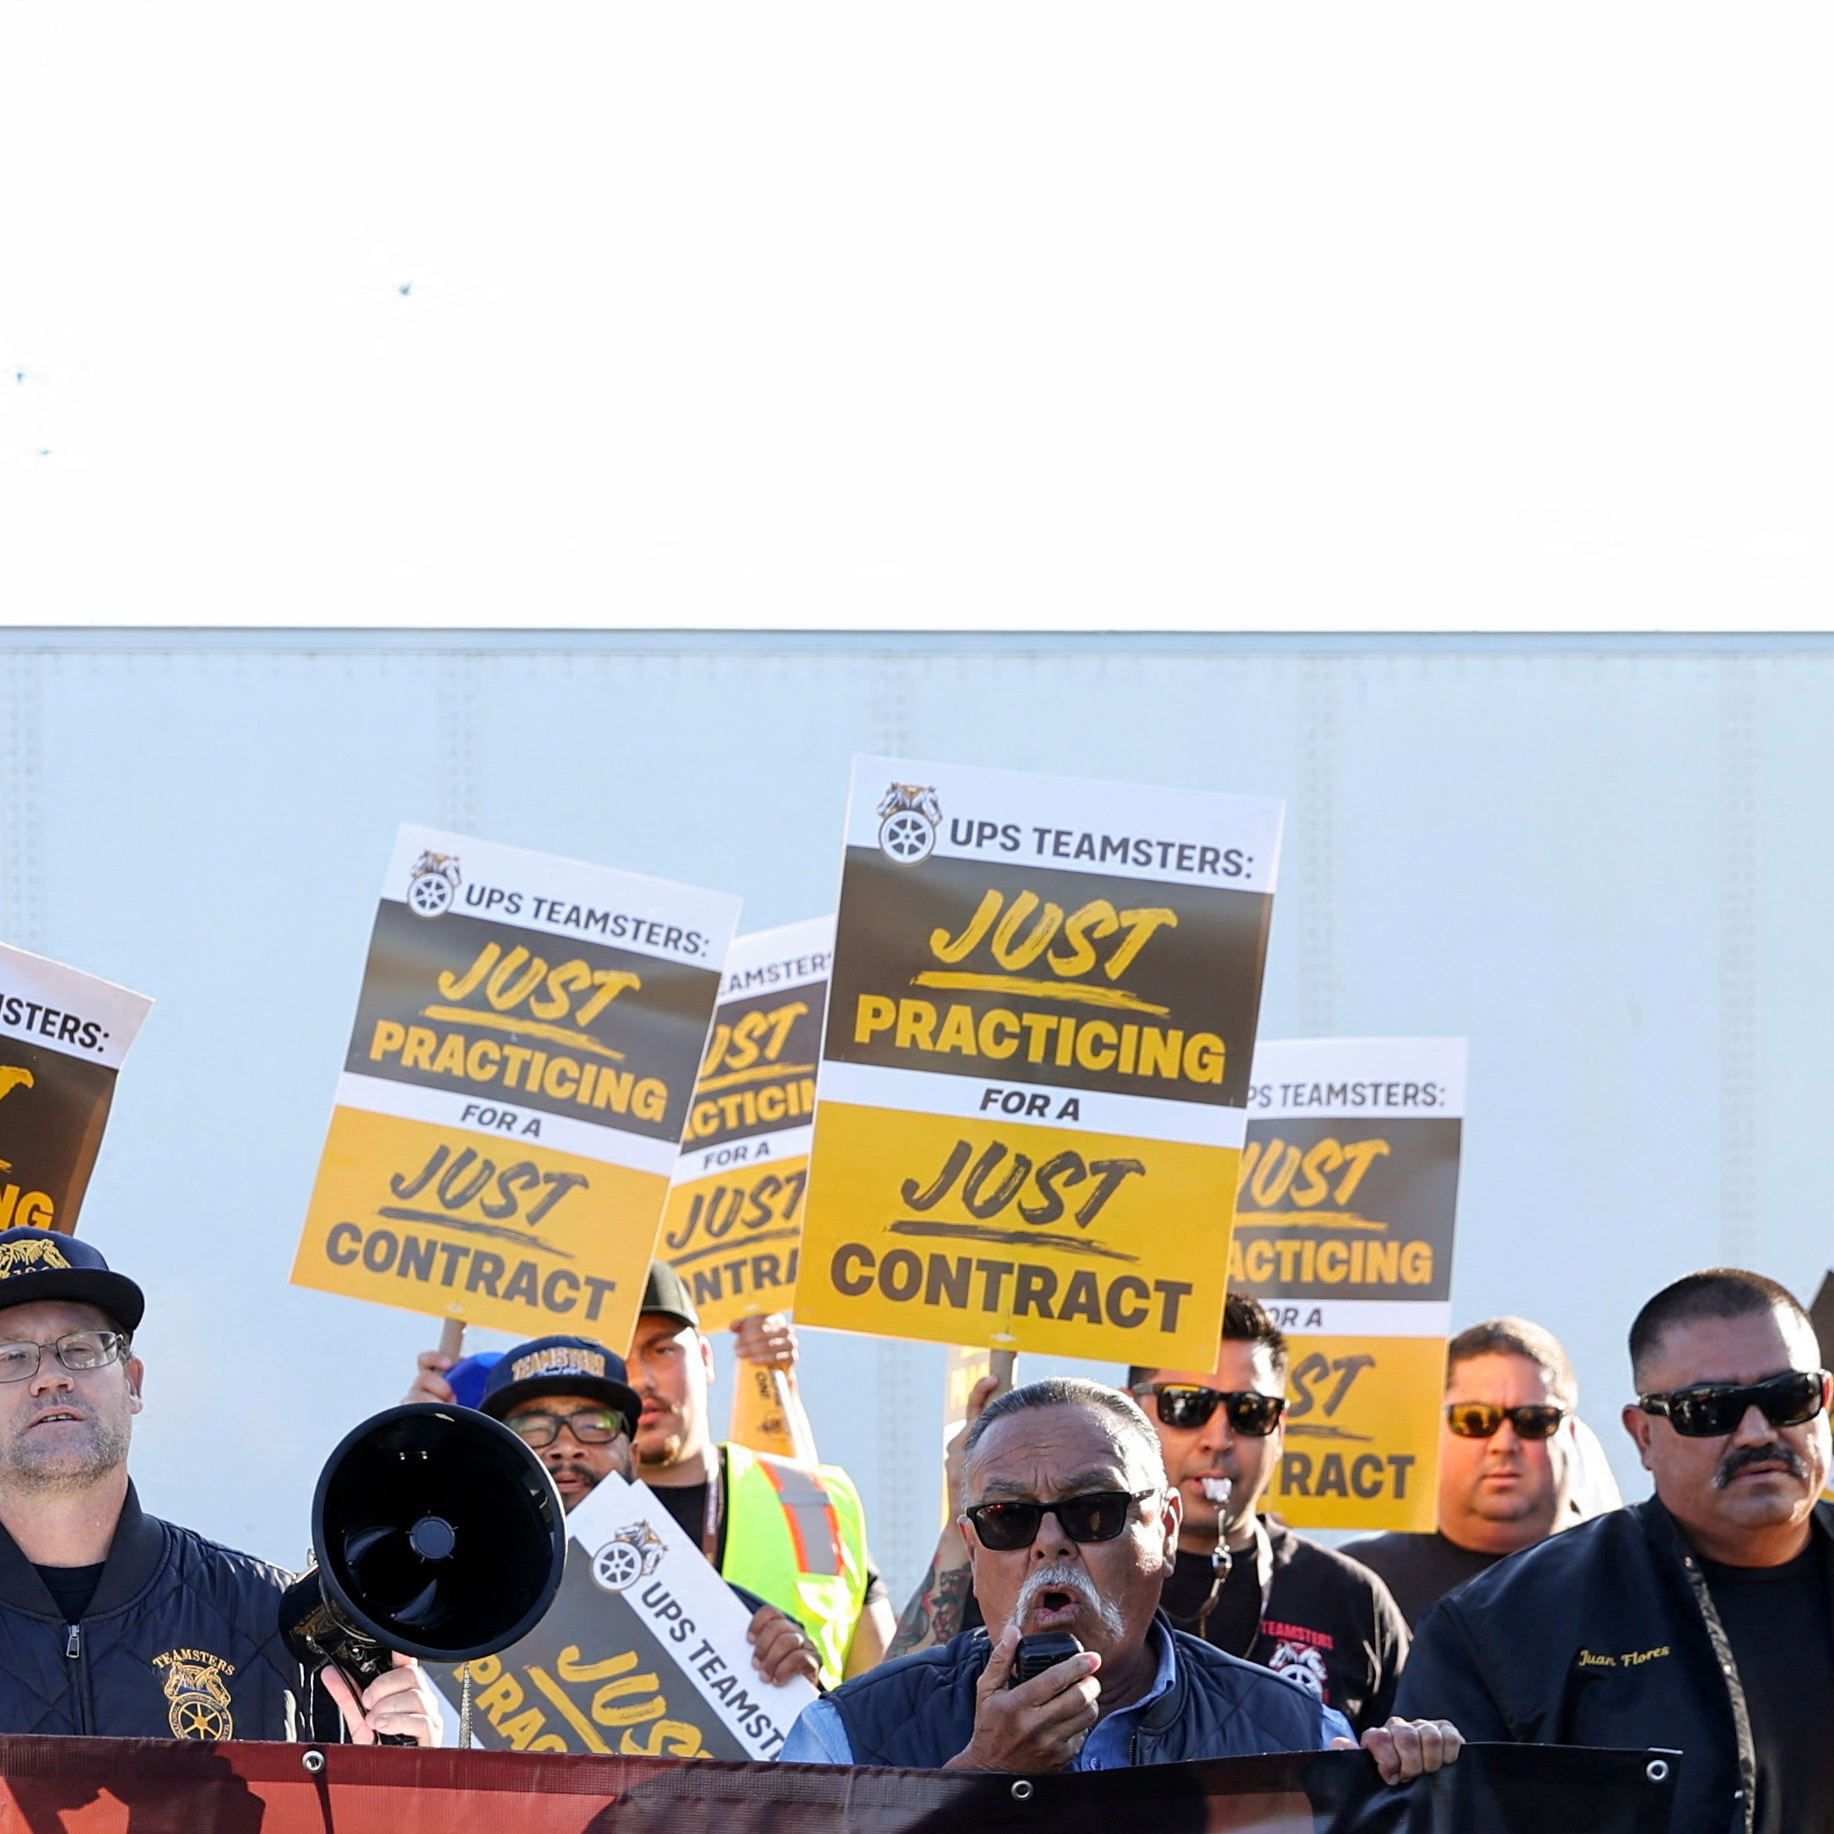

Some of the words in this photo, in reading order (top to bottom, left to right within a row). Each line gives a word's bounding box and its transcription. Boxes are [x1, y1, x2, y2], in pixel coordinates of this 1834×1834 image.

[950, 819, 1020, 854] UPS
[1033, 827, 1254, 878] TEAMSTERS:
[465, 884, 522, 915] UPS
[532, 898, 710, 957] TEAMSTERS:
[930, 889, 1178, 980] JUST
[439, 942, 641, 1027] JUST
[370, 1020, 667, 1122] PRACTICING
[855, 995, 1225, 1084] PRACTICING
[461, 1104, 521, 1133] FOR
[520, 1117, 541, 1138] A
[979, 1089, 1049, 1118] FOR
[1056, 1097, 1080, 1120] A
[1279, 1083, 1445, 1109] TEAMSTERS:
[391, 1144, 589, 1227] JUST
[703, 1151, 747, 1170] FOR
[754, 1142, 770, 1158] A
[900, 1139, 1144, 1229] JUST
[326, 1222, 615, 1322] CONTRACT
[831, 1243, 1191, 1334] CONTRACT
[1302, 1307, 1323, 1328] A
[642, 1582, 695, 1642] UPS
[152, 1649, 235, 1675] TEAMSTERS
[1578, 1649, 1616, 1667] Juan
[1620, 1646, 1670, 1668] Flores
